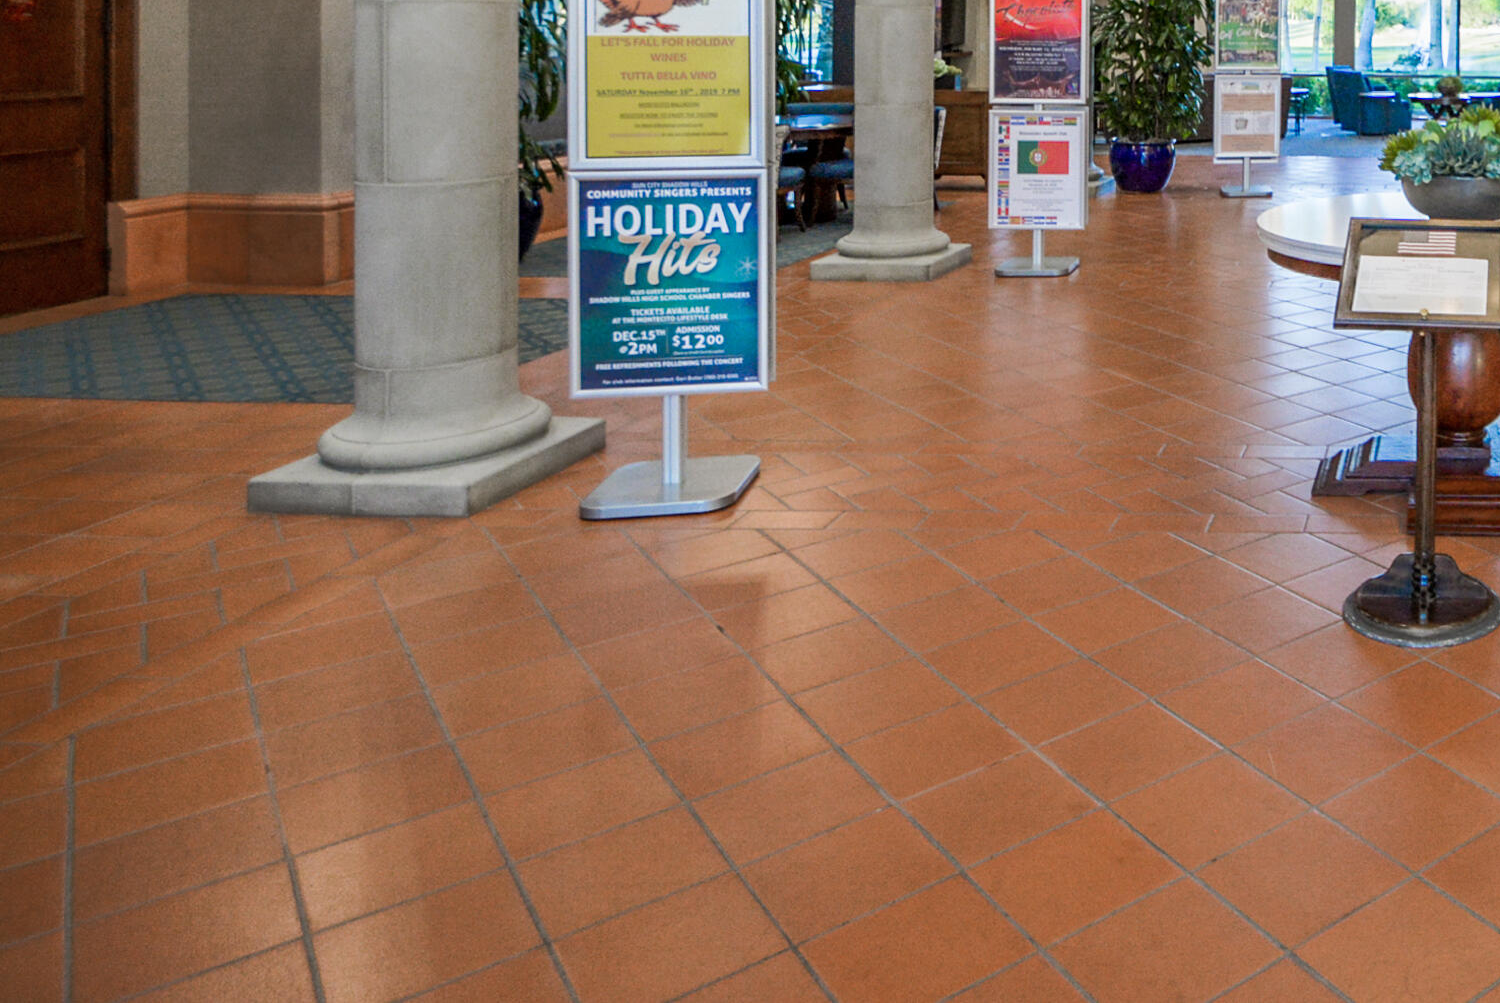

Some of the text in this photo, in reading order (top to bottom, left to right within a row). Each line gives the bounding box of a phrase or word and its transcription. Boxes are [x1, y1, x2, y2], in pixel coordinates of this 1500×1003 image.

[601, 37, 735, 47] LET'S FALL FOR HOLIDAY
[650, 53, 687, 62] WINES
[620, 71, 717, 80] TUTTA BELLA VINO
[639, 88, 677, 96] November
[727, 88, 741, 96] PM
[587, 187, 752, 199] COMMUNITY SINGERS PRESENTS
[586, 202, 752, 238] HOLIDAY
[617, 230, 721, 286] Hits
[722, 291, 750, 299] SINGERS
[630, 306, 710, 316] TICKETS AVAILABLE
[636, 315, 675, 323] MONTECITO
[677, 314, 709, 322] LIFESTYLE
[675, 325, 720, 334] ADMISSION
[613, 361, 661, 370] REFRESHMENTS
[662, 359, 699, 368] FOLLOWING
[714, 357, 743, 366] CONCERT
